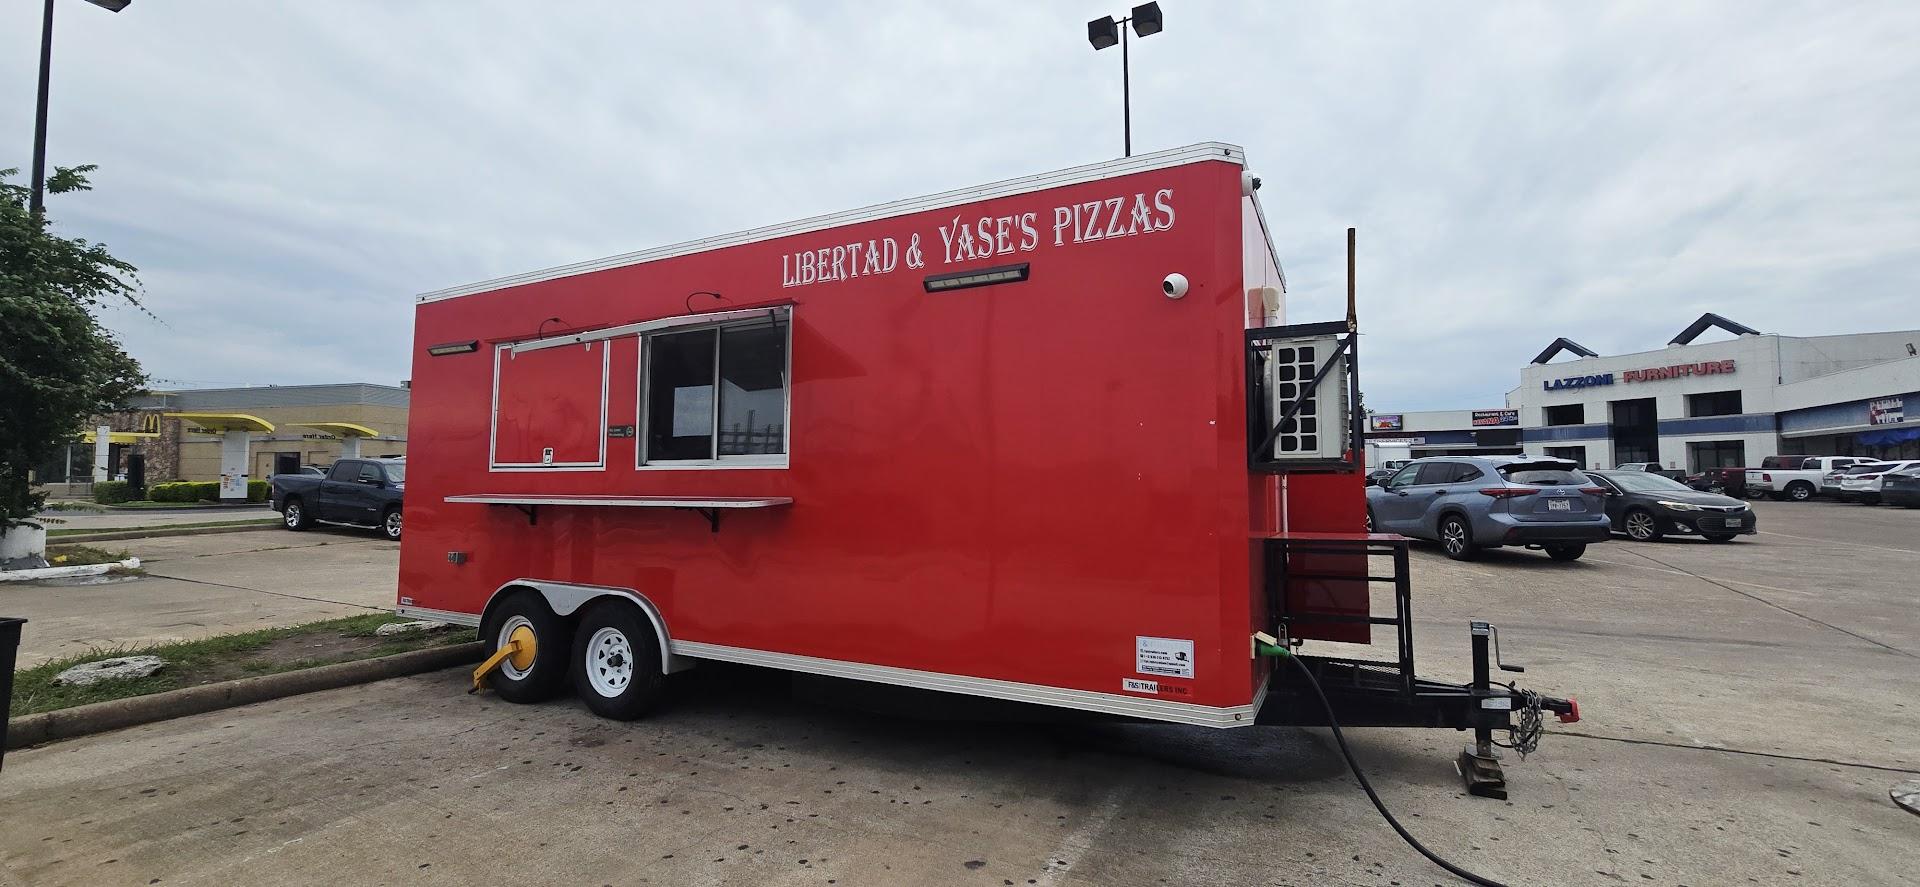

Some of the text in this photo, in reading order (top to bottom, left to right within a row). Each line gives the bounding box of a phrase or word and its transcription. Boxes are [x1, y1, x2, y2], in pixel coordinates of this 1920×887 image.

[782, 188, 1177, 289] LIBERTAD & YASE'S PIZZAS
[1543, 359, 1736, 391] LAZZONI FURNITURE
